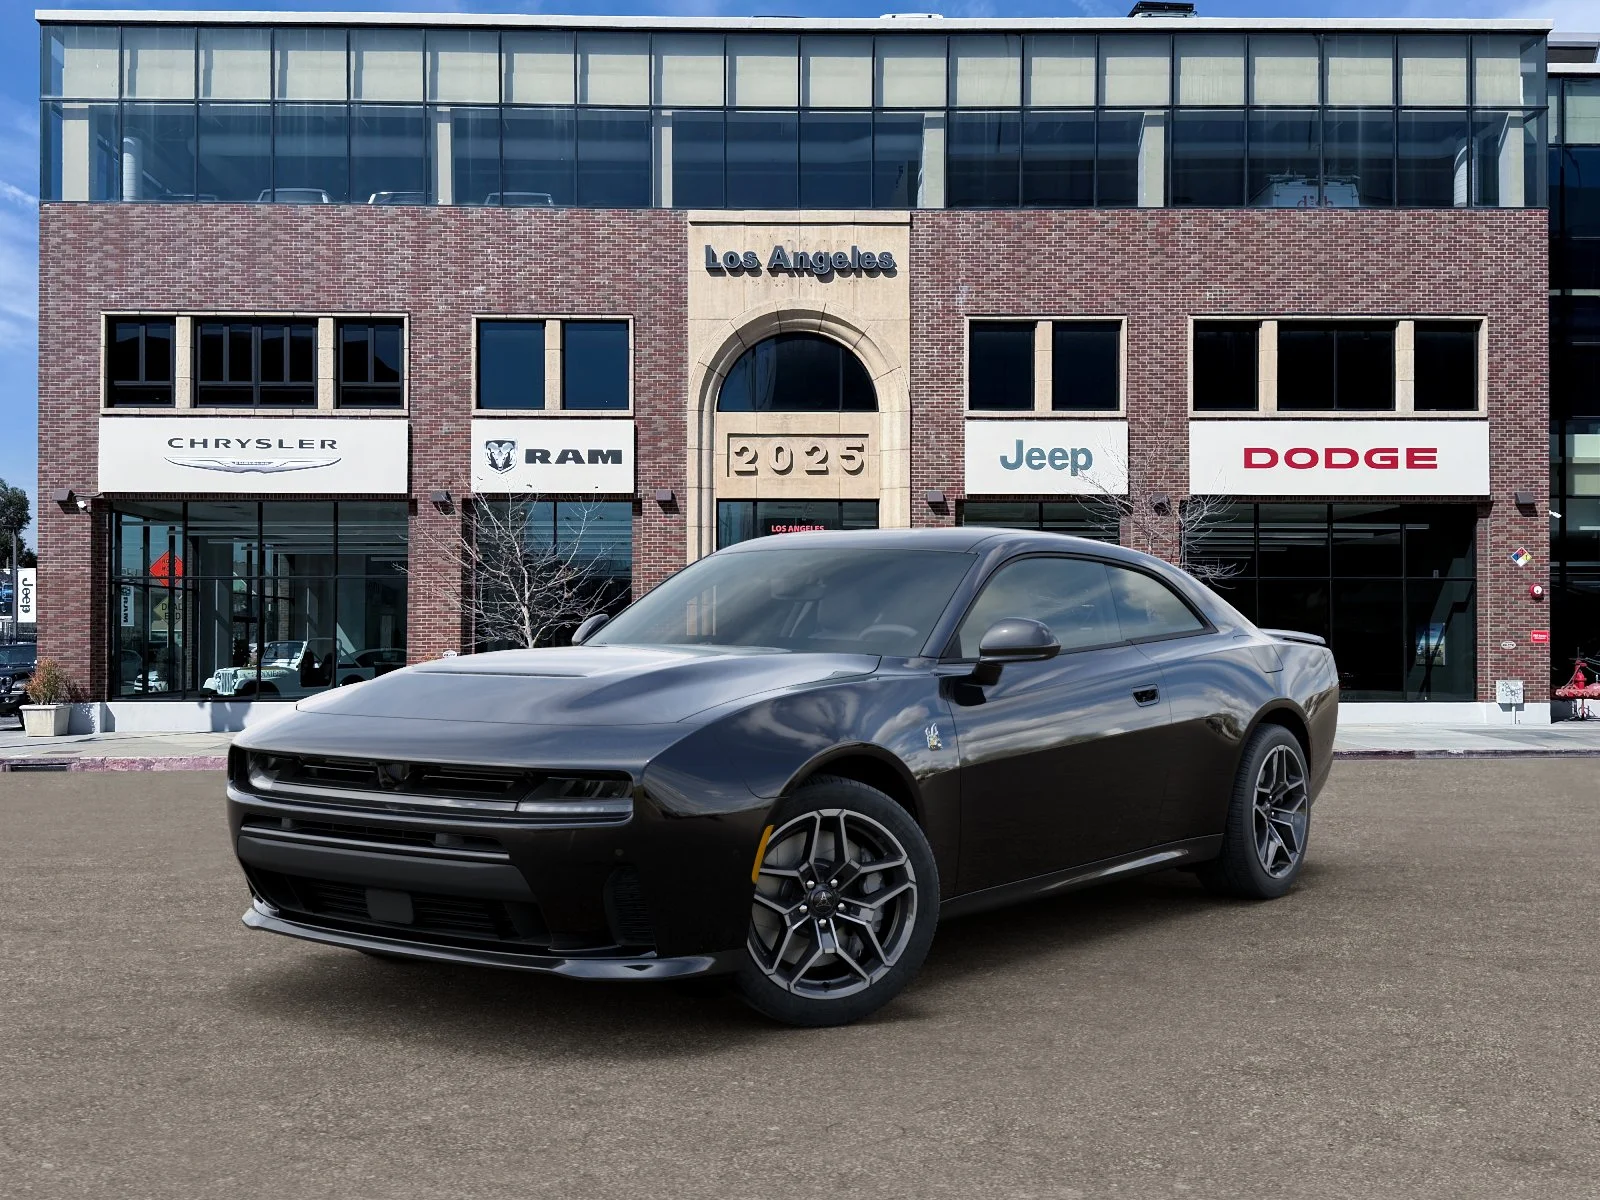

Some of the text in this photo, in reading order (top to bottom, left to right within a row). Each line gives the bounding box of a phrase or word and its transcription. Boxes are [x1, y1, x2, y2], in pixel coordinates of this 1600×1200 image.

[704, 244, 895, 275] Los Angeles
[167, 437, 338, 450] CHRYSLER
[524, 448, 623, 465] RAM
[732, 439, 866, 476] 2025
[999, 438, 1094, 477] Jeep
[1243, 447, 1438, 470] DODGE
[771, 524, 787, 533] LOS
[19, 577, 34, 614] Jeep
